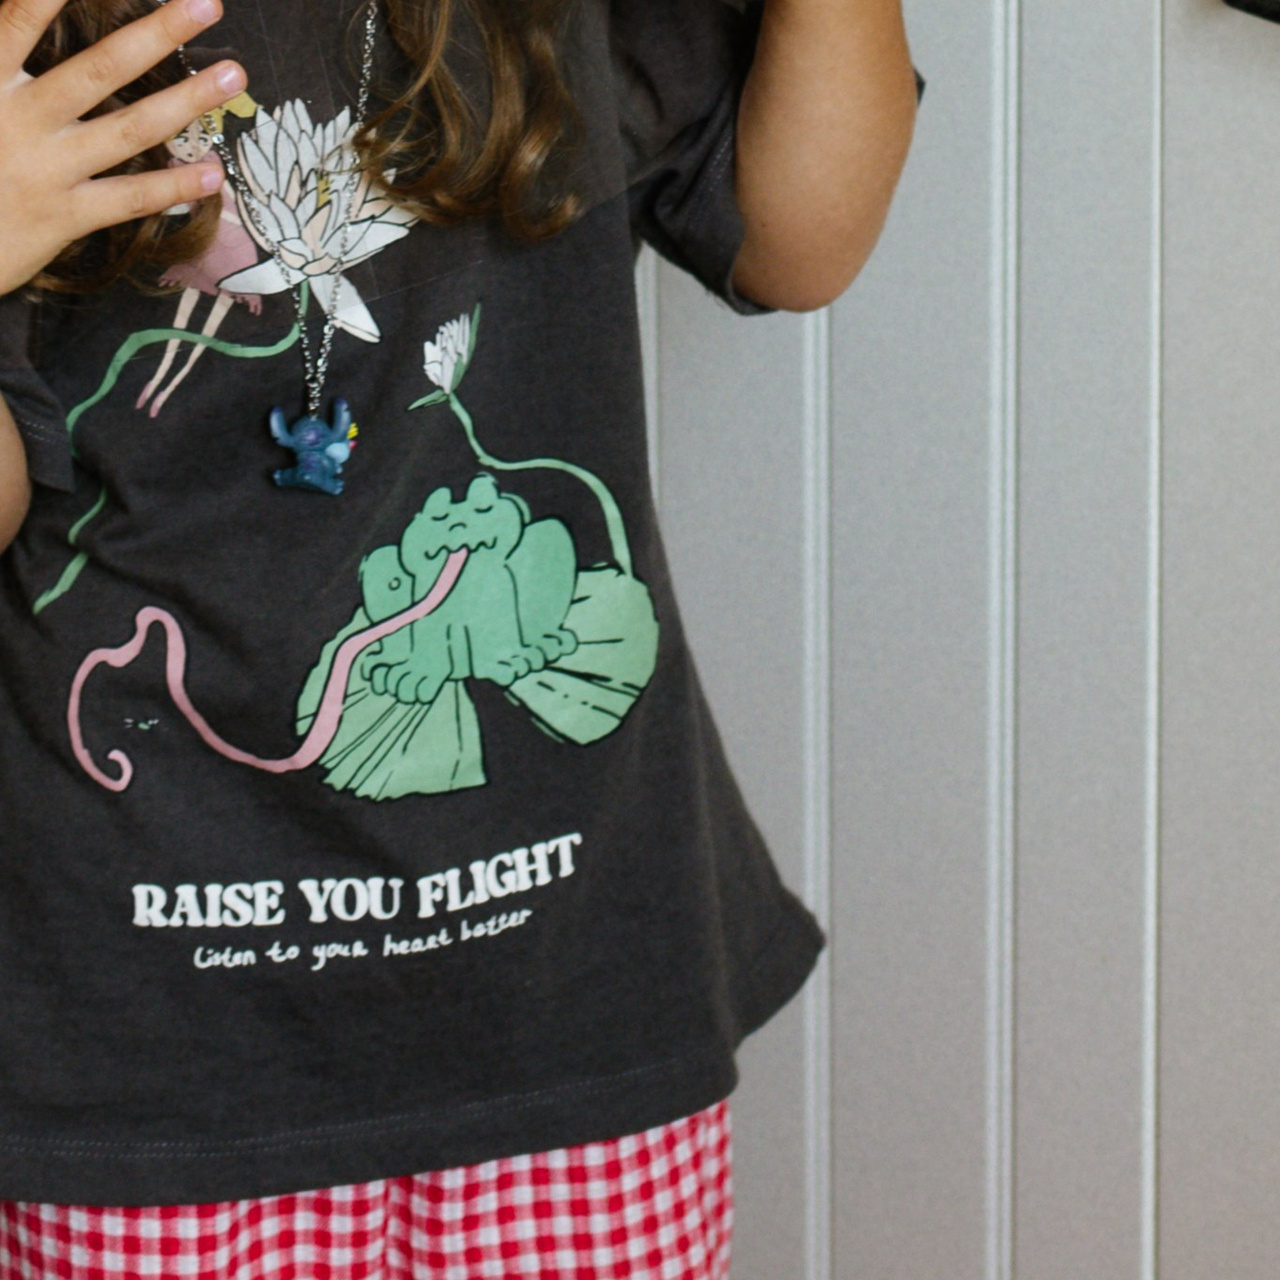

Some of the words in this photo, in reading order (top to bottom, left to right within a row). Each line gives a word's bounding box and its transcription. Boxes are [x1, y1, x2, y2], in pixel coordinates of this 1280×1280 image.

[131, 880, 286, 928] RAISE
[298, 876, 404, 923] YOU
[417, 832, 583, 919] FLIGHT
[265, 941, 300, 963] to
[311, 940, 369, 971] your
[382, 928, 453, 957] heart
